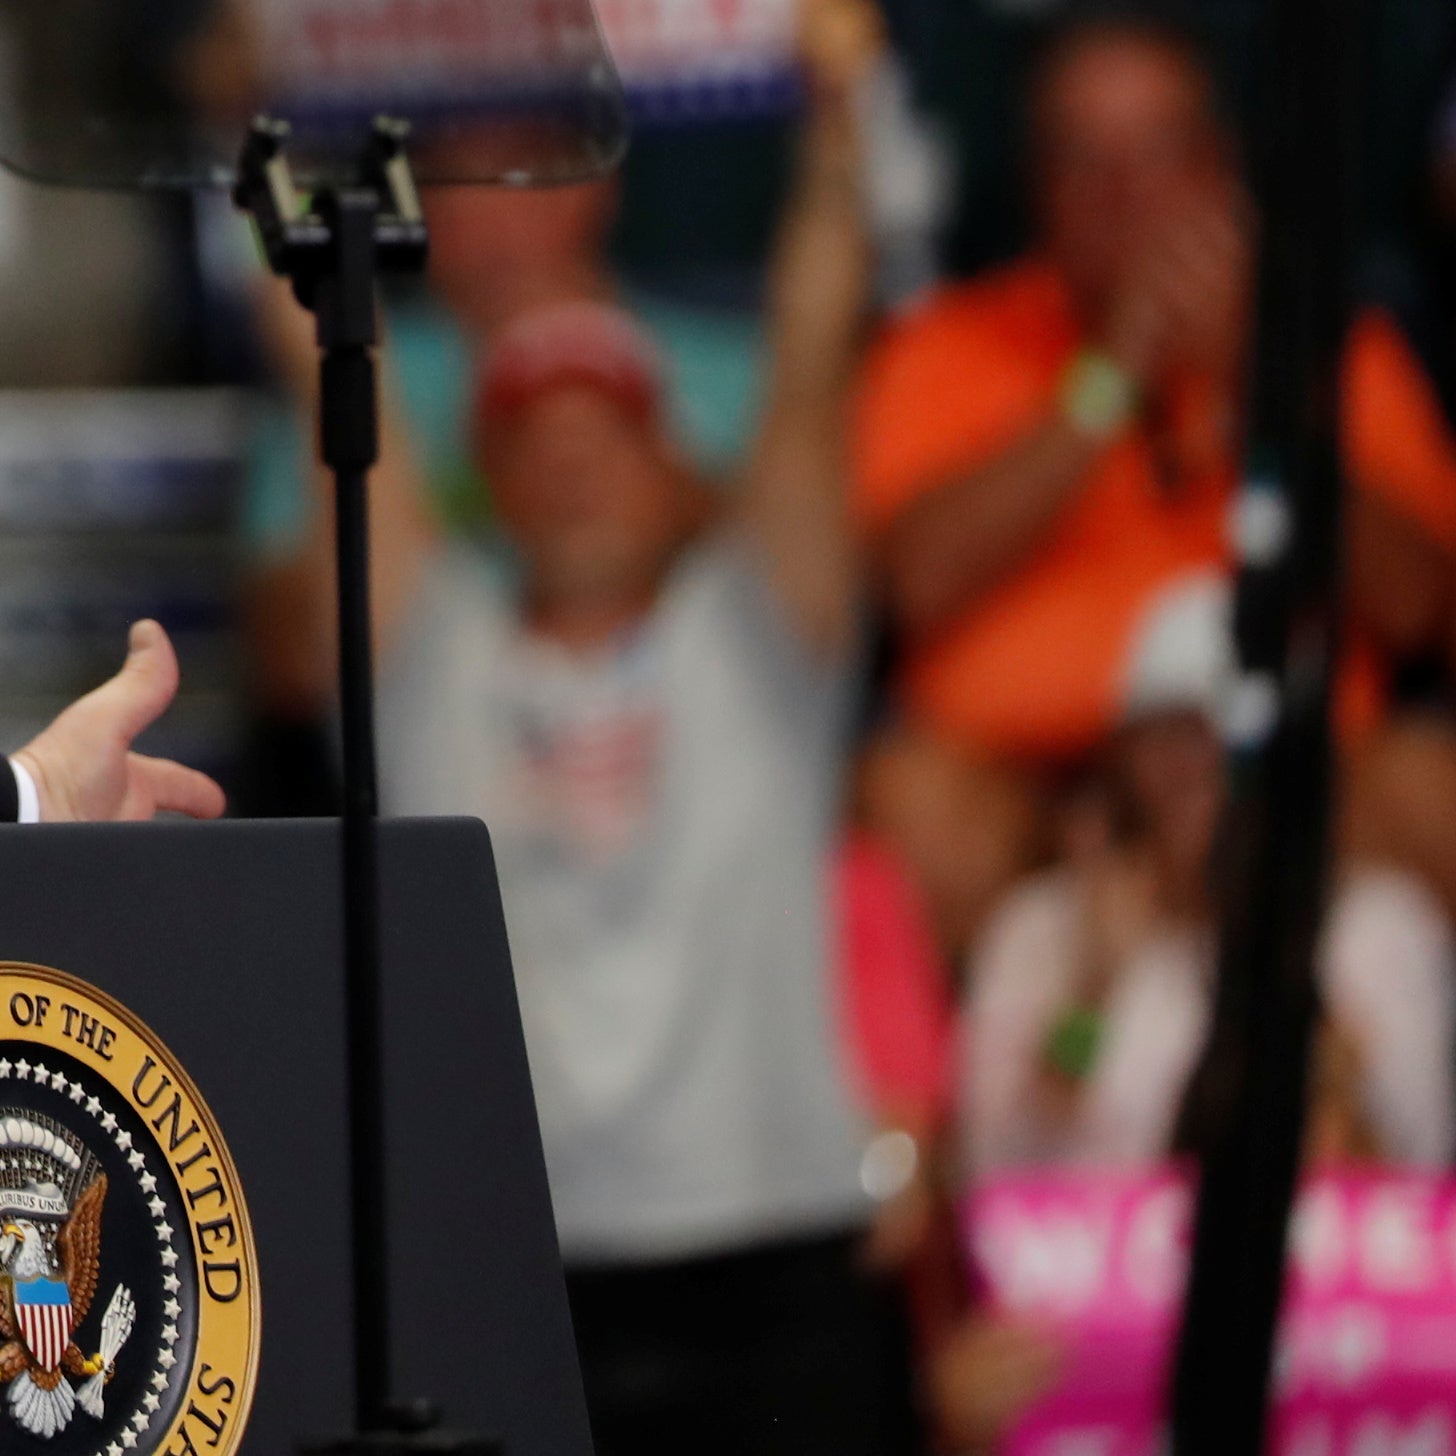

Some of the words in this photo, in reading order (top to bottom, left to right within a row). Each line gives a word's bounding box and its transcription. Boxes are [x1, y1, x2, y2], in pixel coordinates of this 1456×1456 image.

[10, 992, 51, 1027] OF
[61, 1003, 117, 1061] THE
[132, 1055, 243, 1304] UNITED
[162, 1362, 236, 1456] STA
